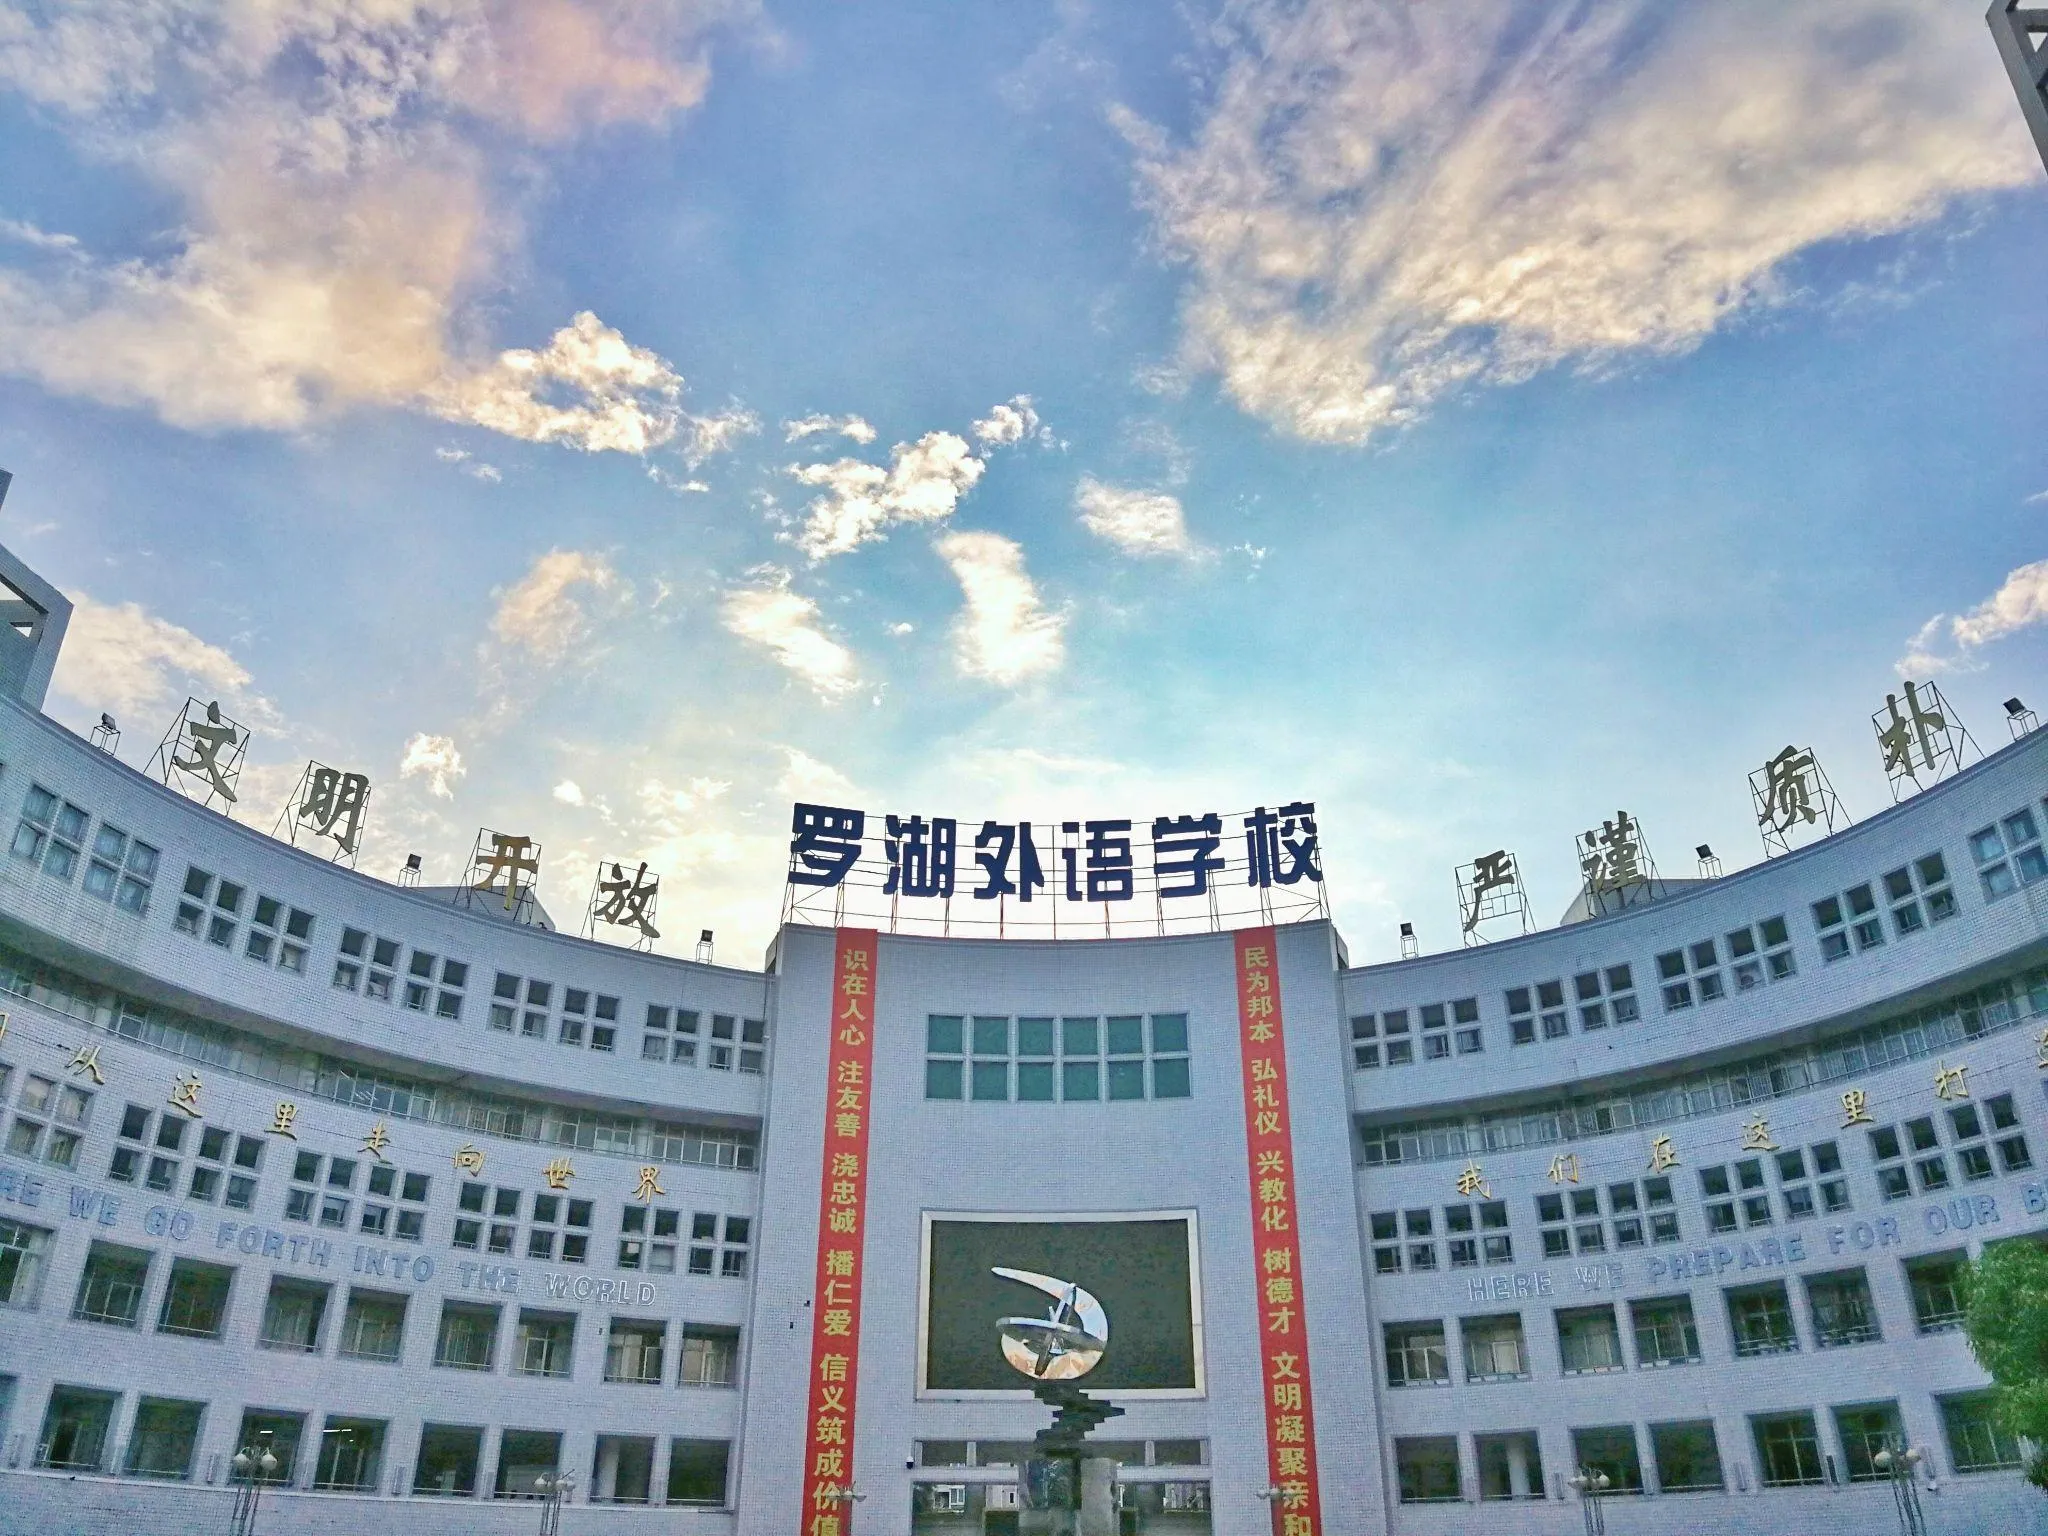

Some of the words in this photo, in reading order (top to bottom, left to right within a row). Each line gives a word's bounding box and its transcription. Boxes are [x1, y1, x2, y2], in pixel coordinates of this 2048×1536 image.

[788, 801, 1322, 902] 罗湖外语学校
[838, 948, 869, 1046] 识在人心
[1245, 946, 1275, 1043] 民为邦本
[834, 1060, 864, 1137] 注友善
[1251, 1058, 1281, 1135] 弘礼仪
[828, 1153, 859, 1233] 浇忠诚
[1257, 1151, 1289, 1231] 兴教化
[70, 1186, 121, 1225] WE
[144, 1205, 194, 1241] GO
[216, 1221, 332, 1268] FORTH
[354, 1245, 434, 1282] INTO
[458, 1260, 521, 1293] THE
[545, 1272, 656, 1306] WORLD
[1467, 1271, 1554, 1302] HERE
[1576, 1264, 1626, 1292] WE
[1649, 1237, 1805, 1284] PREPARE
[1827, 1216, 1901, 1254] FOR
[1924, 1193, 1999, 1235] OUR
[823, 1249, 854, 1336] 播仁爱
[1263, 1247, 1295, 1334] 树德才
